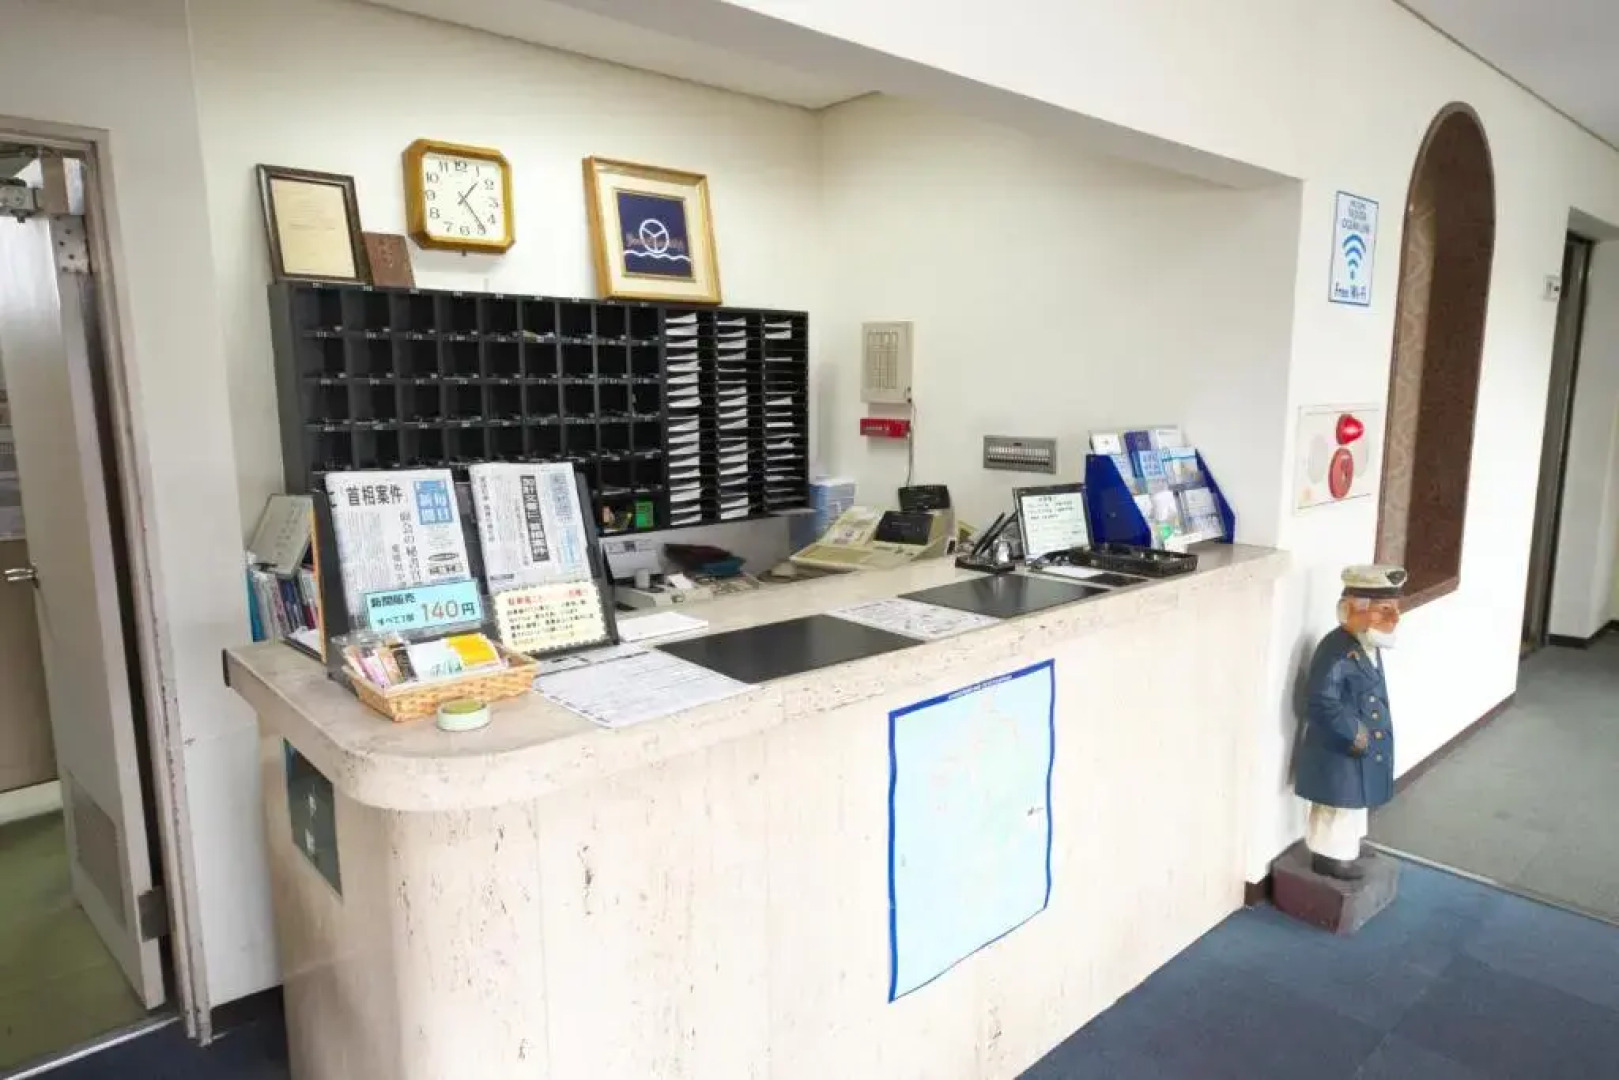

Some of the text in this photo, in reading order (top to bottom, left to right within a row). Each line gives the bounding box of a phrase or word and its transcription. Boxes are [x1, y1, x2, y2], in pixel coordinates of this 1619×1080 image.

[439, 160, 449, 173] 11
[454, 160, 468, 173] 12
[426, 171, 439, 184] 10
[484, 178, 494, 190] 2
[425, 189, 436, 201] 9
[430, 206, 440, 219] 8
[487, 214, 496, 225] 4
[443, 221, 454, 233] 7
[459, 226, 470, 236] 6
[1334, 282, 1349, 298] Free
[345, 483, 403, 507] 首相案件
[371, 592, 416, 608] 新聞販売
